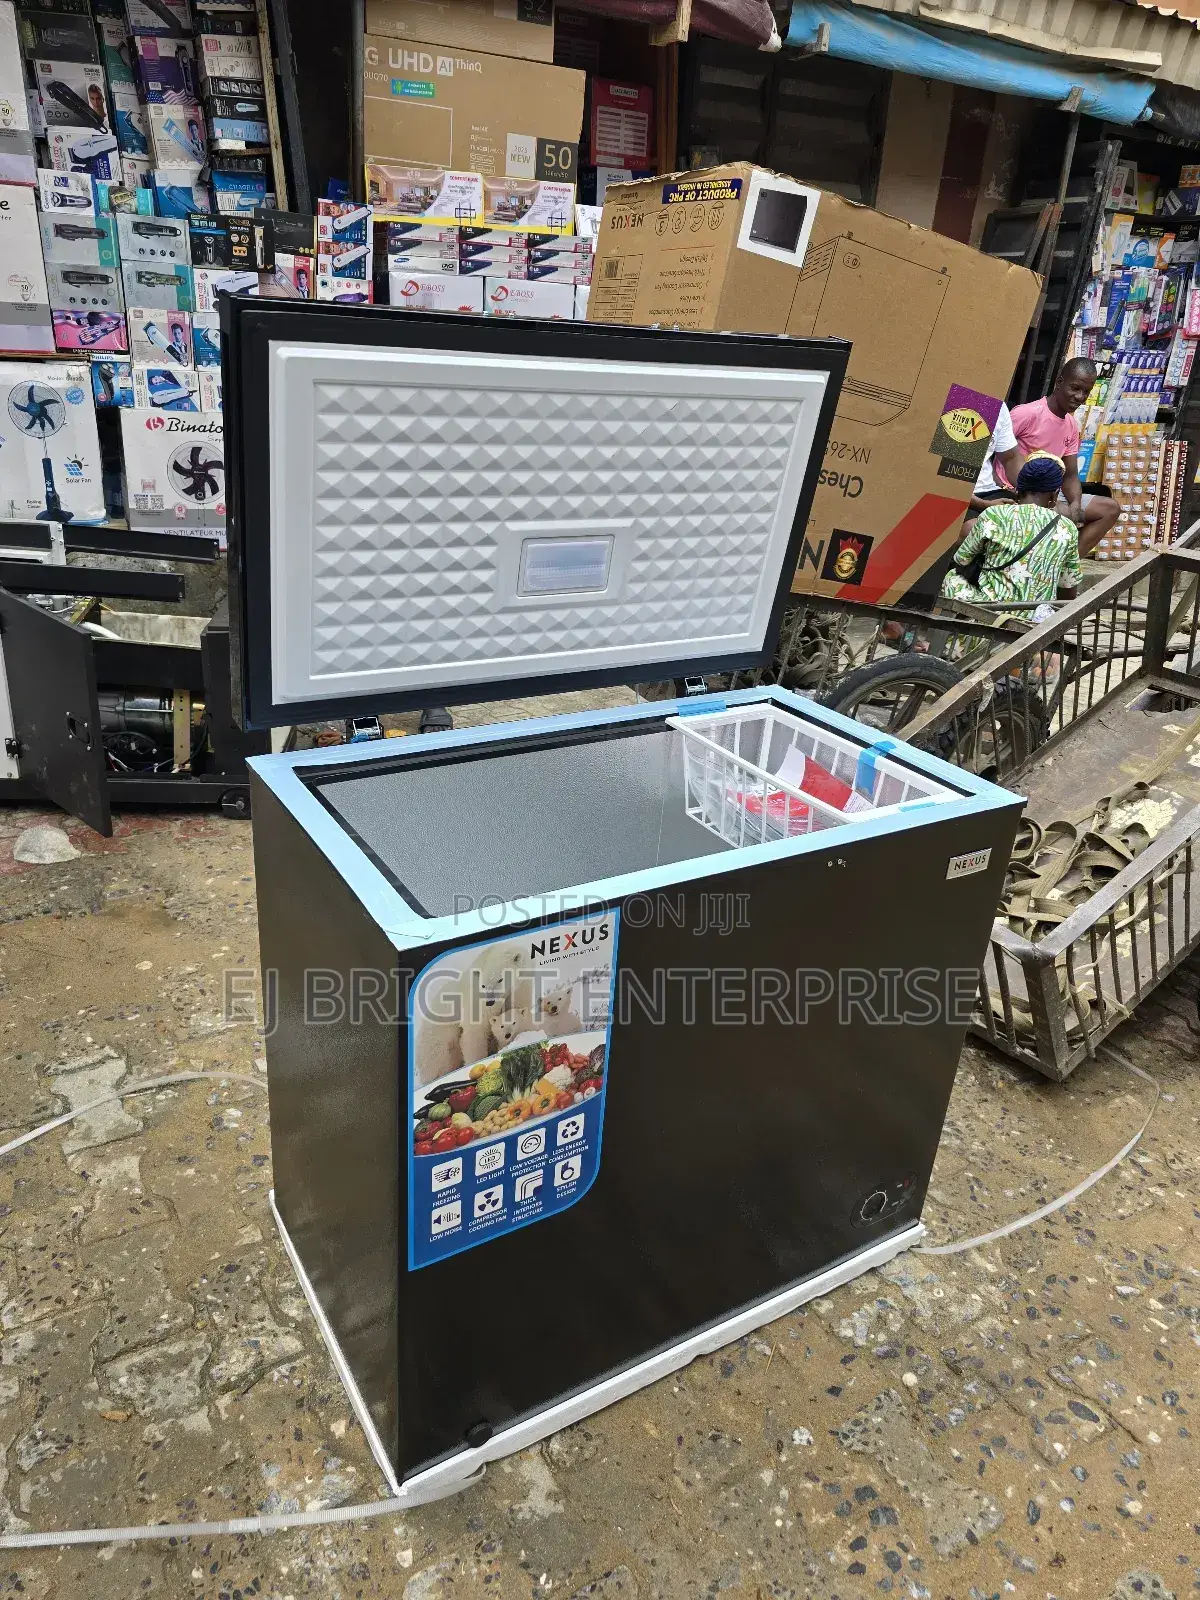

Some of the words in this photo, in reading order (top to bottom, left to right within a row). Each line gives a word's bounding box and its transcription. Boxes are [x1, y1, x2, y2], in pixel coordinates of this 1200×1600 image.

[364, 46, 379, 66] G
[388, 47, 434, 73] UHD
[455, 58, 483, 74] ThinQ
[510, 153, 531, 164] NEW
[543, 143, 572, 170] 50
[703, 179, 733, 189] ASSEMBLED
[668, 191, 685, 203] PRC
[685, 190, 697, 202] OF
[696, 188, 738, 201] PRODUCT
[610, 212, 645, 230] NEXUS
[166, 416, 224, 434] Binato
[826, 439, 872, 465] NX-26
[944, 463, 978, 479] FRONT
[817, 468, 864, 498] Ches
[163, 529, 214, 537] VENTILATEUR
[953, 854, 987, 871] NEXUS
[530, 923, 609, 960] NEXUS
[539, 956, 561, 966] LIVING
[565, 1138, 587, 1151] ENERGY
[548, 1144, 589, 1164] CONSUMPTION
[509, 1162, 524, 1172] LOW
[511, 1161, 547, 1178] PROTECTION
[476, 1175, 488, 1185] LED
[488, 1168, 506, 1180] LIGHT
[437, 1187, 457, 1199] RAPID
[556, 1180, 577, 1192] STYLISH
[556, 1186, 577, 1199] DESIGN
[432, 1192, 461, 1208] FREEZING
[520, 1196, 537, 1207] THICK
[468, 1207, 508, 1227] COMPRESSOR
[511, 1206, 544, 1223] STRUCTURE
[468, 1219, 496, 1233] COOLING
[495, 1214, 507, 1224] FAN
[429, 1231, 444, 1243] LOW
